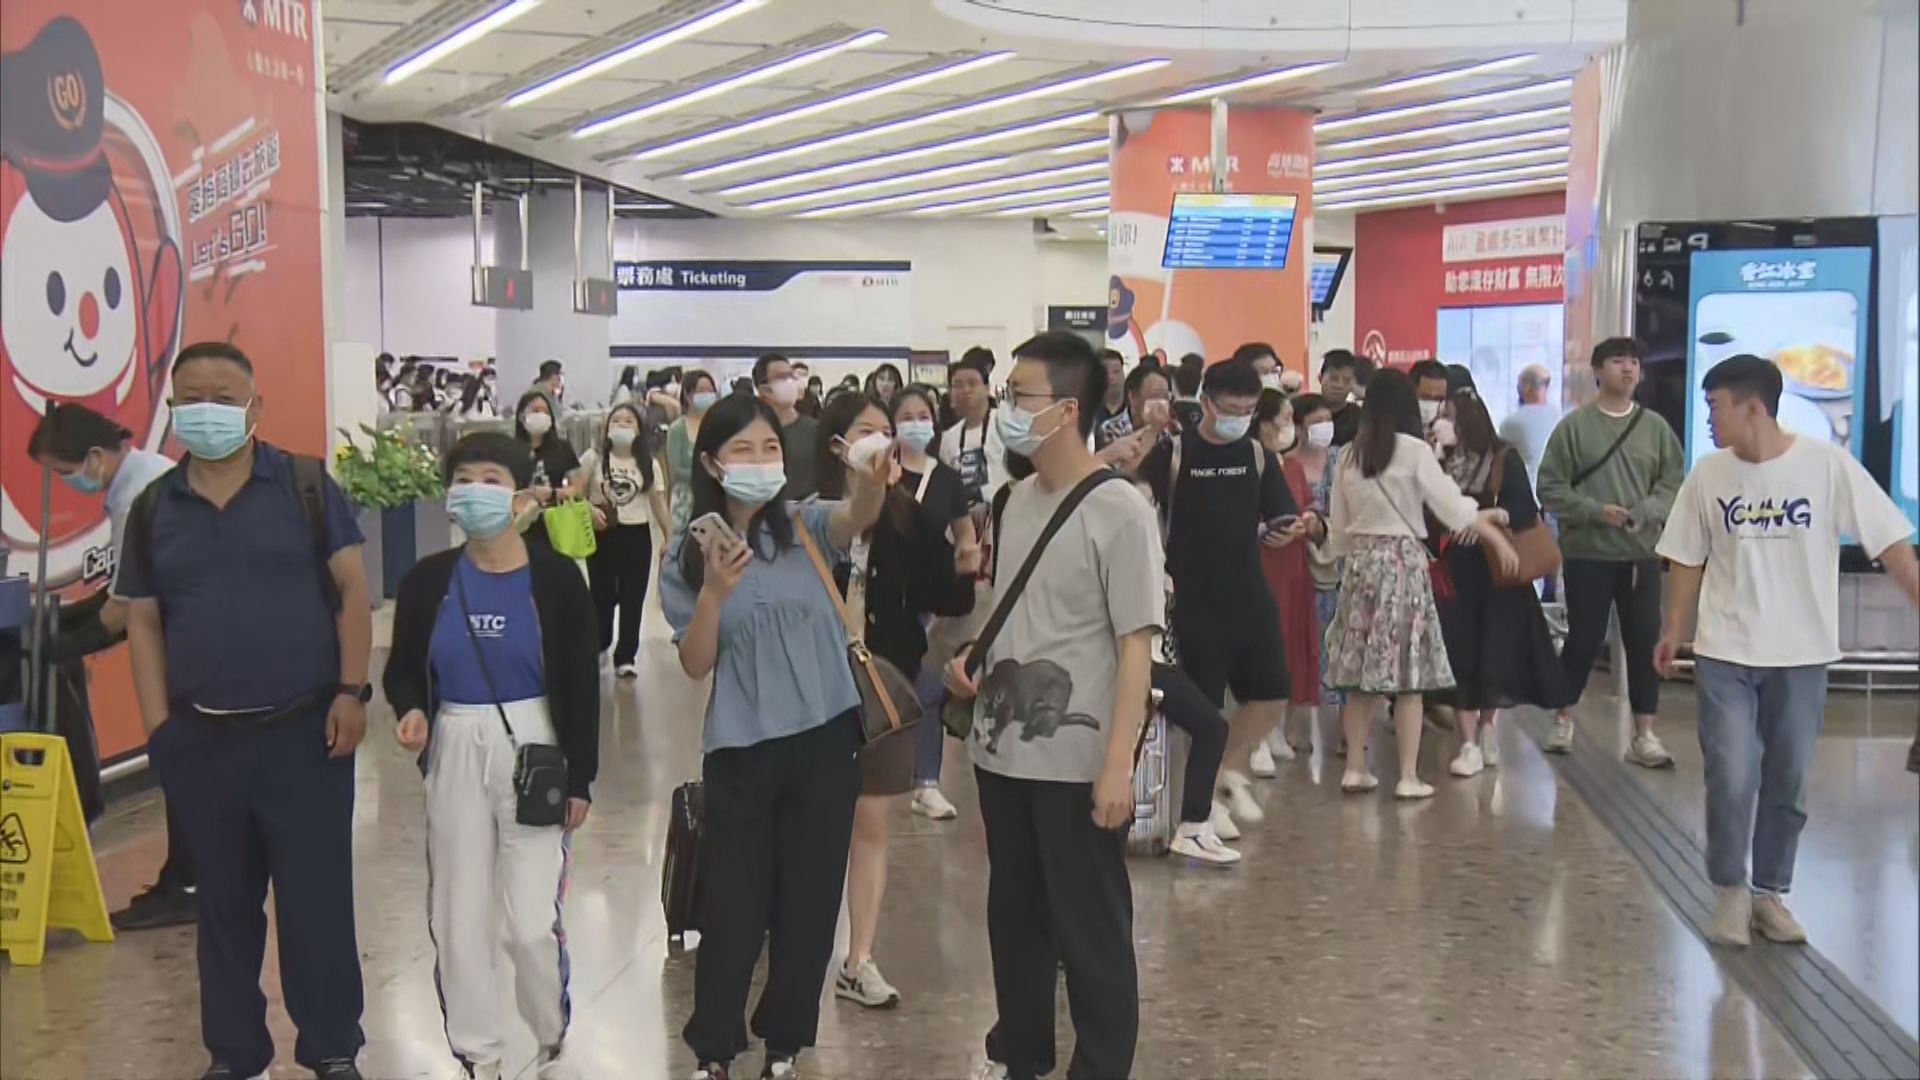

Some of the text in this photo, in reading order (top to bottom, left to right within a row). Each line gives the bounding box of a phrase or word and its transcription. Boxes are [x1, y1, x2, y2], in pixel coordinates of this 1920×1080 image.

[263, 0, 308, 42] MTR
[55, 74, 80, 110] GO
[1191, 156, 1239, 174] MR
[681, 269, 746, 287] Ticketing
[1190, 466, 1248, 478] MAGIC FOREST
[1716, 495, 1812, 534] YOUNG
